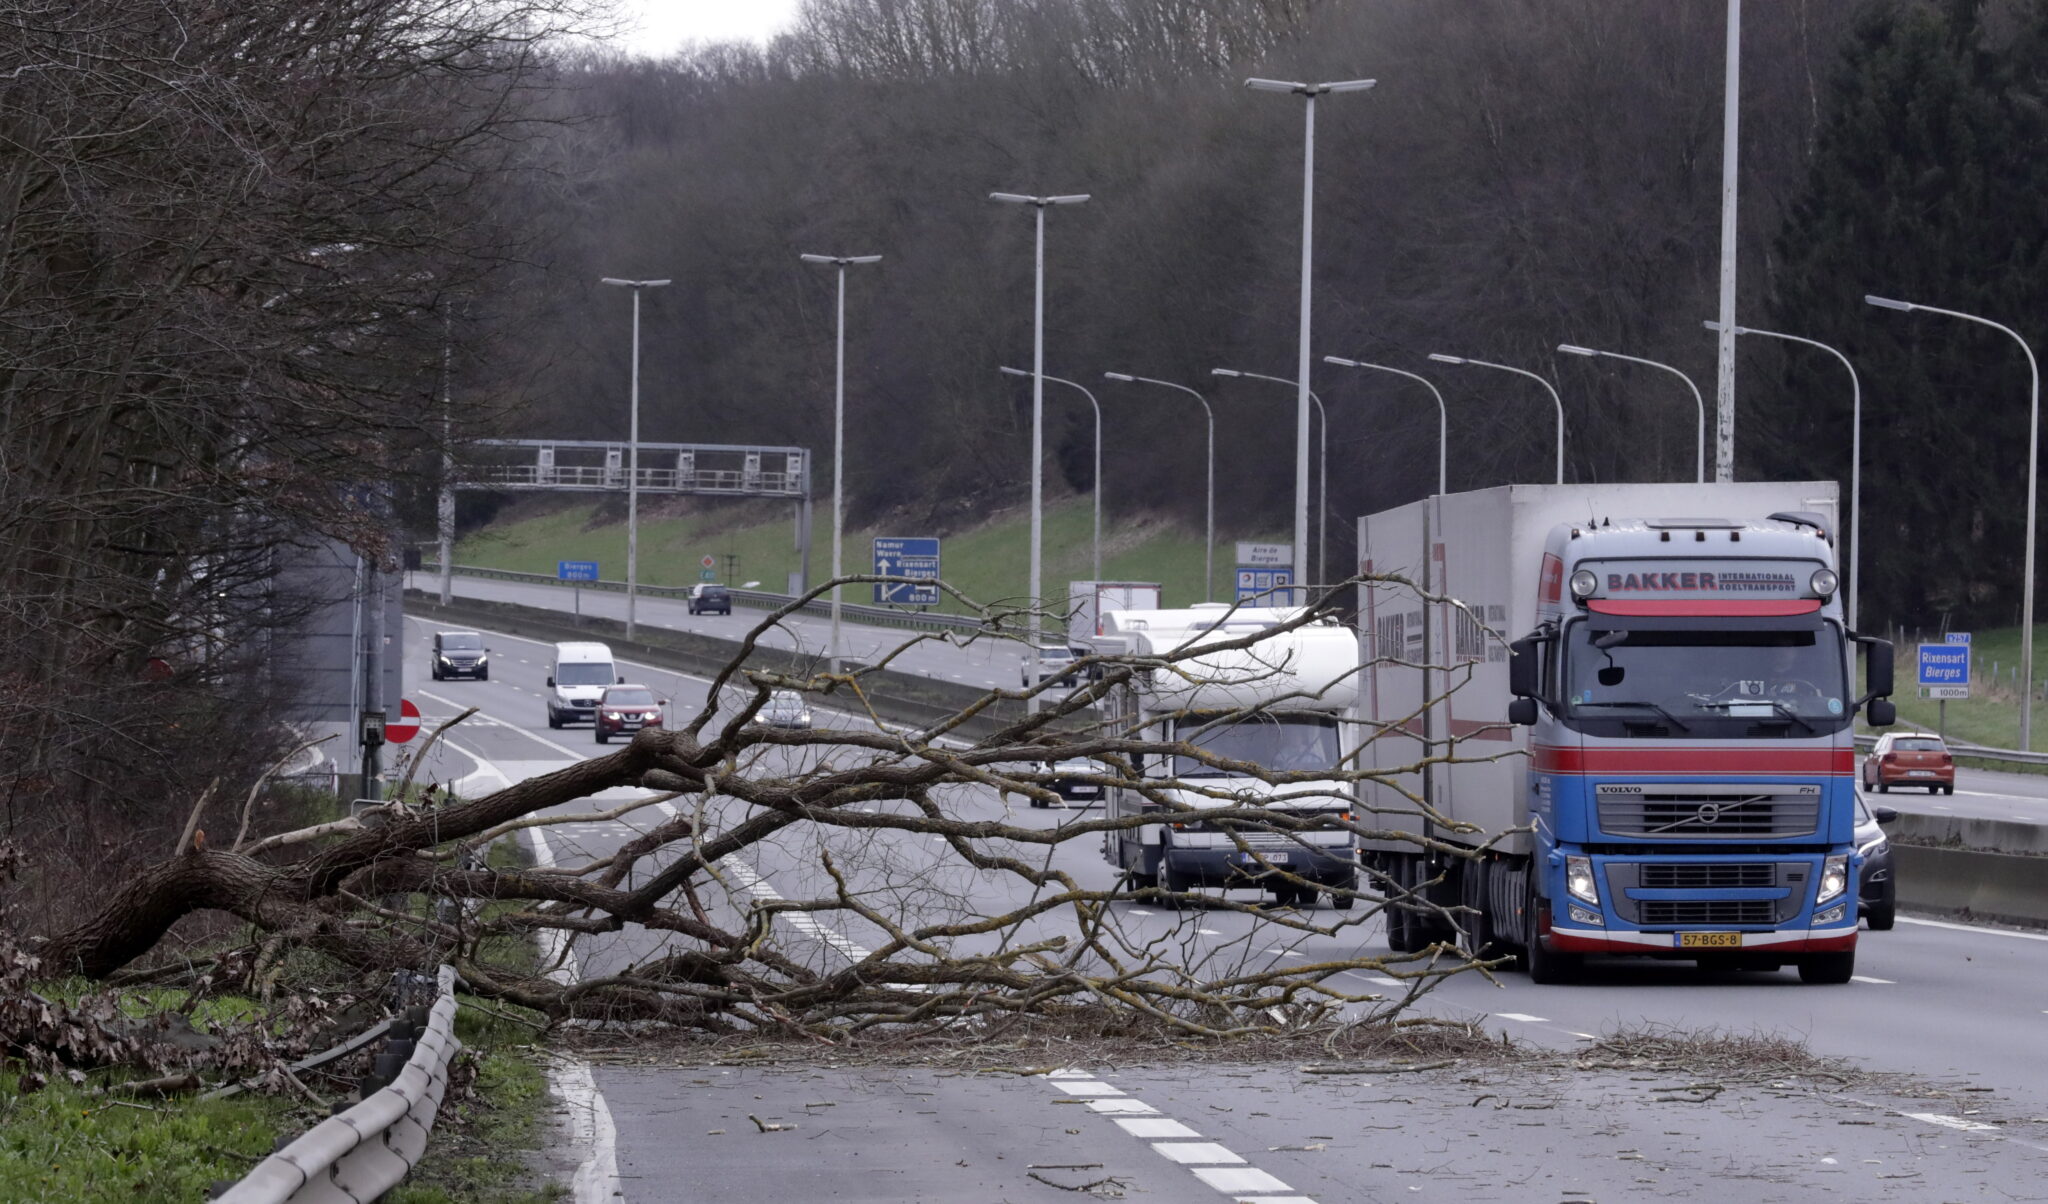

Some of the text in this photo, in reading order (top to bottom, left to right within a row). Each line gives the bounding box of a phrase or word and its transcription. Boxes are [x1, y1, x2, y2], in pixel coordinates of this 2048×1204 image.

[877, 541, 904, 549] Namur
[1252, 546, 1278, 554] Aire de
[1251, 555, 1278, 564] Bierges
[896, 560, 936, 568] Rixensart
[904, 569, 936, 577] Bierges
[1607, 572, 1795, 592] BAKKER INTERNATIONAAL
[1718, 584, 1796, 592] KOELTRANSPORT
[1922, 652, 1965, 664] Rixensart
[1925, 666, 1961, 680] Bierges
[1940, 689, 1967, 697] 1000m
[1683, 935, 1737, 945] 57-BGS-8
